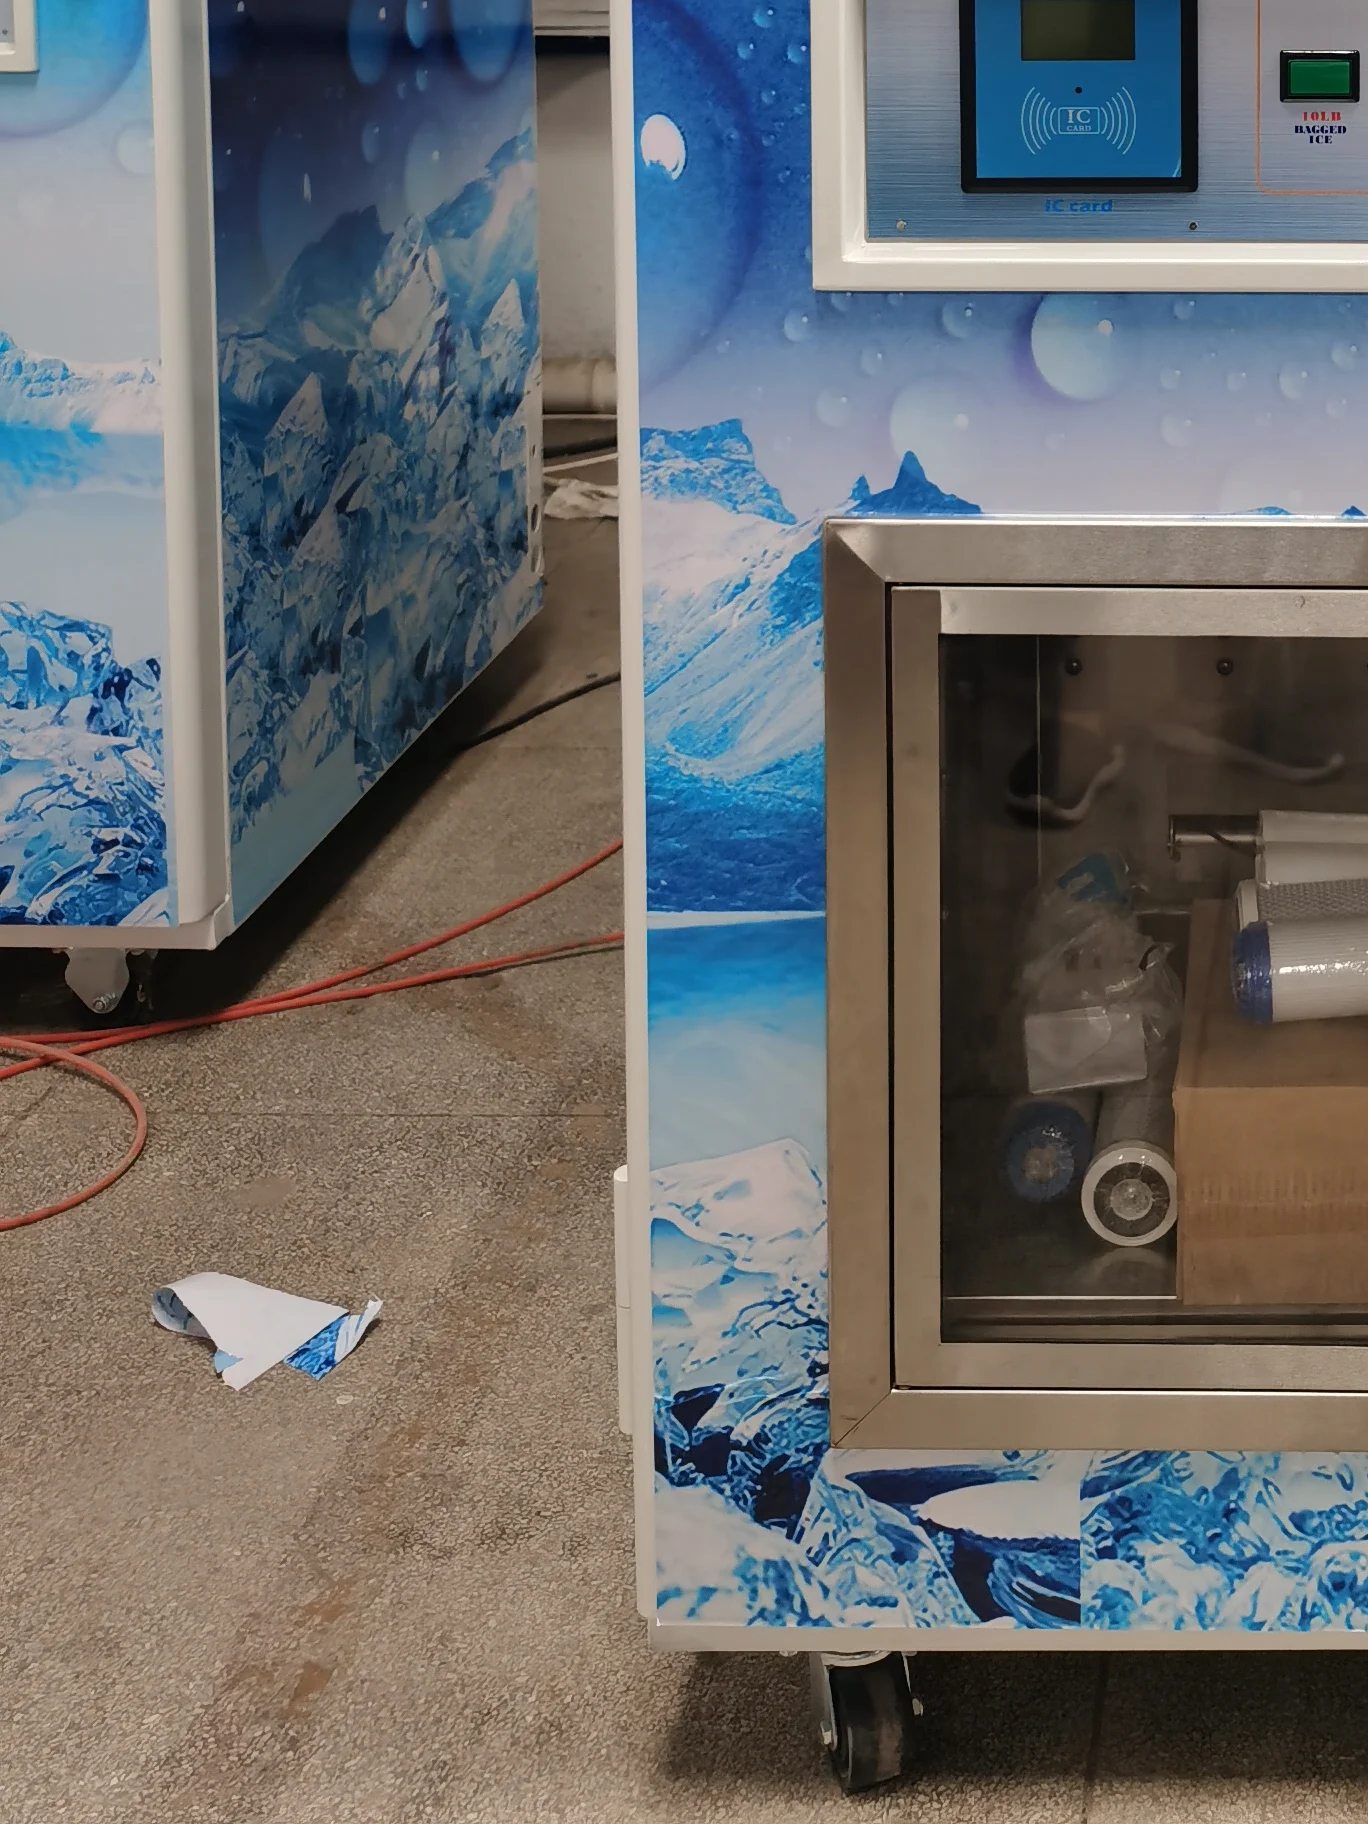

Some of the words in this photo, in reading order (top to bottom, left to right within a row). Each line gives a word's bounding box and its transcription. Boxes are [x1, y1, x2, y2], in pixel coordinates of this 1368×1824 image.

[1067, 109, 1091, 124] IC
[1302, 111, 1341, 122] 10LB
[1294, 125, 1347, 135] BAGGED
[1309, 135, 1333, 144] ICE
[1045, 199, 1066, 213] IC
[1070, 199, 1113, 213] card
